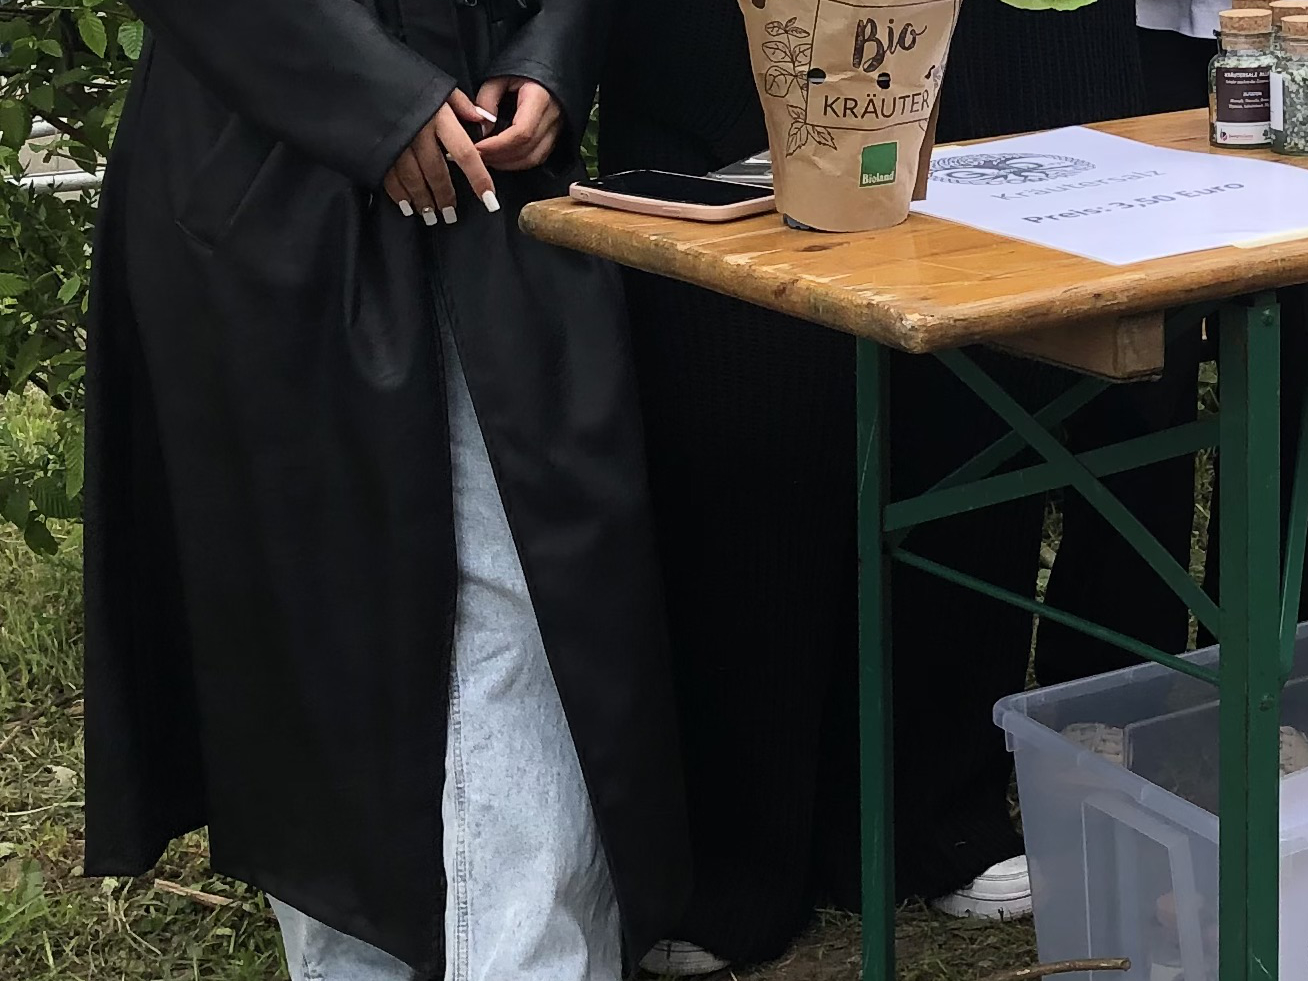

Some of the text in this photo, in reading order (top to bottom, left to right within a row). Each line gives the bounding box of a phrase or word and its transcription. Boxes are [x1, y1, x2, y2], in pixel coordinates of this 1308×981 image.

[852, 17, 928, 73] Bio
[823, 89, 930, 119] KRÄUTER
[862, 171, 896, 185] Bioland
[990, 169, 1167, 201] Kräutersalz
[1021, 182, 1245, 224] Preis: 3,50 Euro
